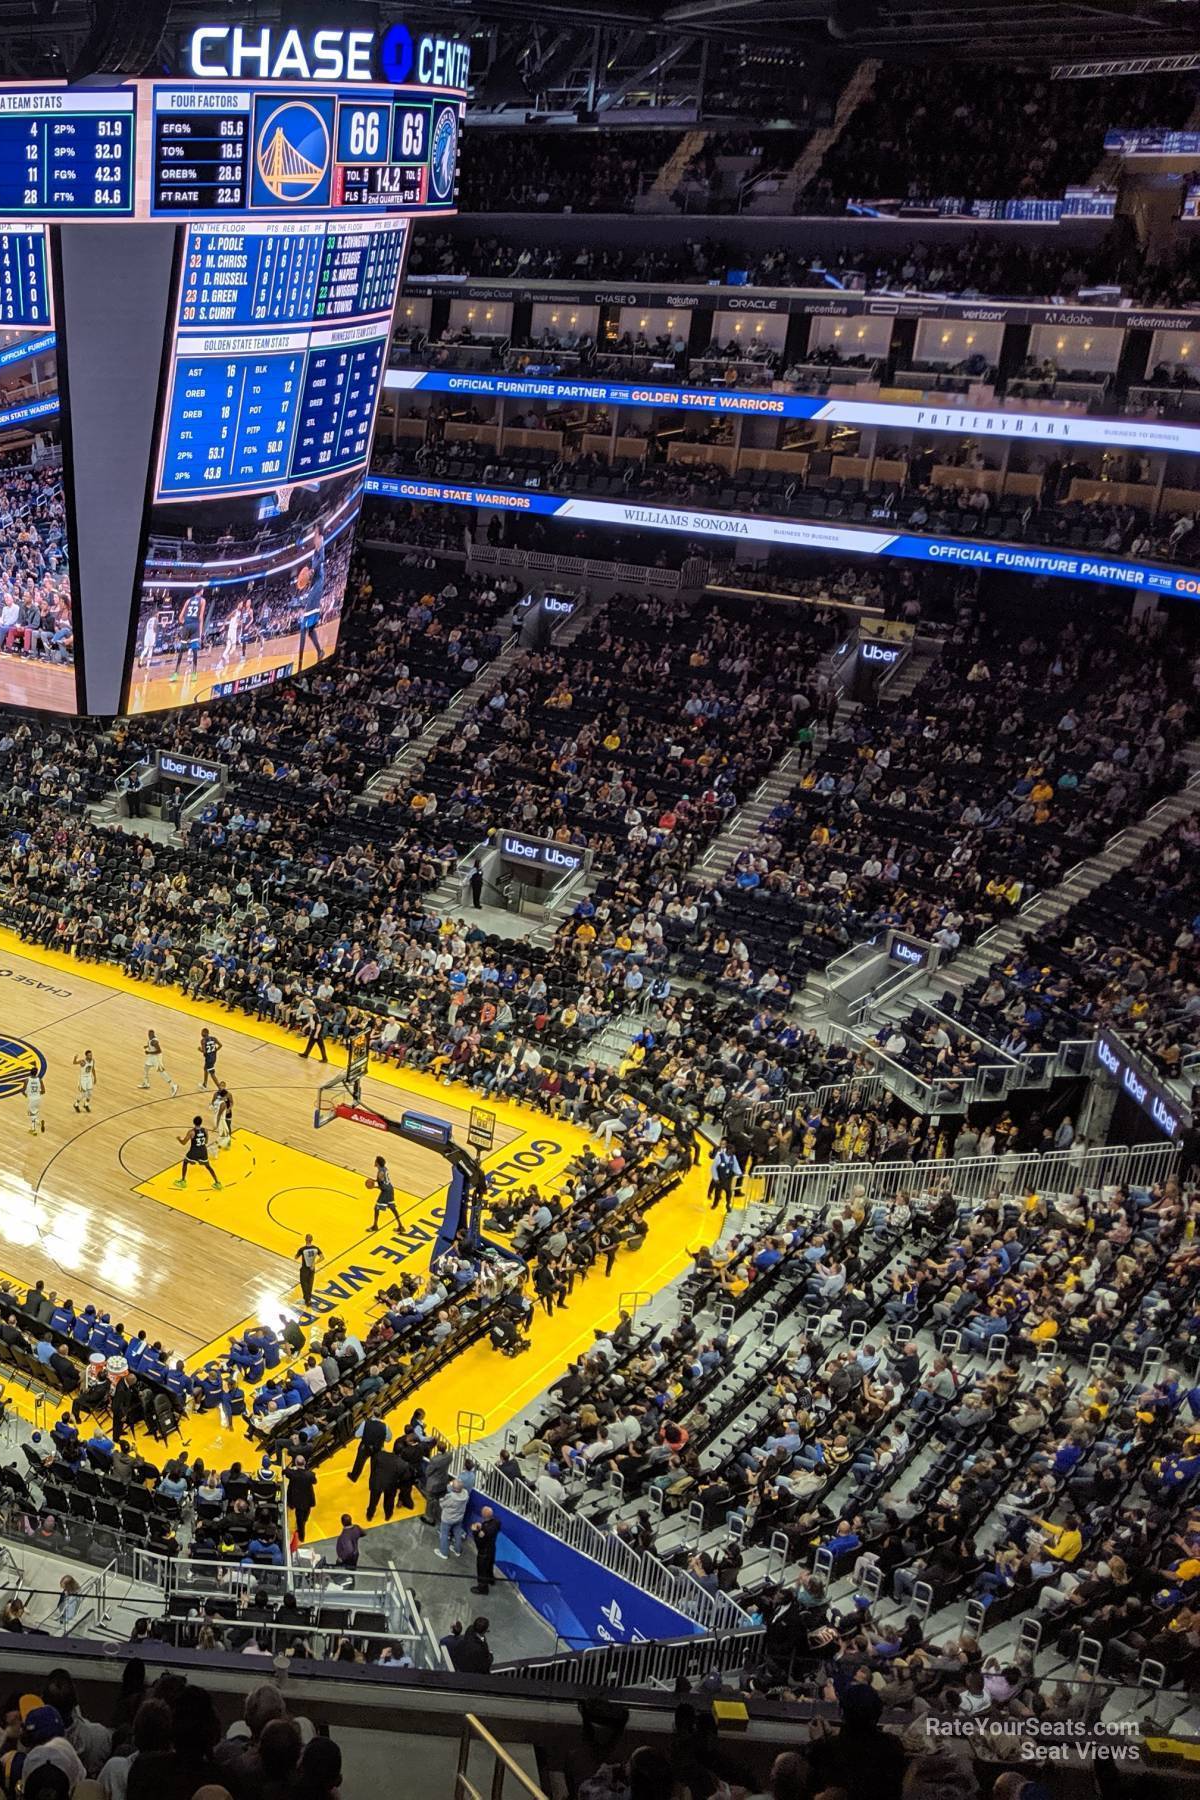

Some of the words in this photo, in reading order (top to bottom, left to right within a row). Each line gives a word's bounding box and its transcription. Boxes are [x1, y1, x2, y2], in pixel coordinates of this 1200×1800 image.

[190, 27, 374, 80] CHASE
[7, 97, 31, 110] TEAM
[32, 96, 63, 109] STATS
[170, 95, 196, 108] FOUR
[197, 95, 239, 108] FACTORS
[30, 122, 38, 137] 4
[54, 124, 76, 135] 2P%
[98, 121, 123, 137] 51.9
[162, 122, 191, 134] EFG%
[219, 120, 244, 136] 65.6
[349, 111, 379, 156] 66
[401, 112, 424, 156] 63
[25, 145, 38, 161] 12
[54, 147, 76, 158] 3P%
[95, 143, 122, 160] 32.0
[162, 146, 185, 157] TO%
[221, 143, 243, 158] 18.5
[27, 166, 38, 182] 11
[54, 169, 76, 180] FG%
[94, 166, 122, 182] 42.3
[161, 168, 197, 179] OREB%
[218, 166, 242, 181] 28.6
[376, 170, 401, 192] 14.2
[23, 189, 38, 204] 28
[54, 191, 75, 203] FT%
[94, 188, 121, 204] 84.6
[161, 191, 174, 201] FT
[176, 191, 199, 201] RATE
[217, 188, 241, 203] 22.9
[595, 294, 627, 304] CHASE
[667, 295, 699, 306] Rakuten
[729, 299, 778, 310] ORACLE
[804, 303, 848, 315] accenture
[963, 311, 1001, 321] verizon
[1058, 315, 1094, 325] Adobe
[1127, 316, 1192, 329] ticketmaster
[448, 378, 494, 390] OFFICIAL
[496, 381, 554, 396] FURNITURE
[557, 385, 606, 399] PARTNER
[632, 390, 679, 404] GOLDEN
[681, 394, 716, 407] STATE
[719, 397, 784, 412] WARRIORS
[400, 484, 441, 498] GOLDEN
[443, 489, 473, 502] STATE
[475, 492, 531, 508] WARRIORS
[623, 509, 690, 527] WILLIAMS
[693, 515, 749, 534] SONOMA
[928, 545, 993, 563] OFFICIAL
[995, 552, 1078, 574] FURNITURE
[1080, 562, 1145, 584] PARTNER
[544, 597, 574, 614] Uber
[863, 644, 898, 663] Uber
[161, 757, 188, 775] Uber
[190, 763, 219, 782] Uber
[504, 838, 540, 859] Uber
[545, 847, 581, 869] Uber
[896, 945, 922, 964] Uber
[12, 974, 73, 998] CHASE
[1098, 1040, 1121, 1075] Uber
[1124, 1067, 1148, 1105] Uber
[1152, 1097, 1178, 1136] Uber
